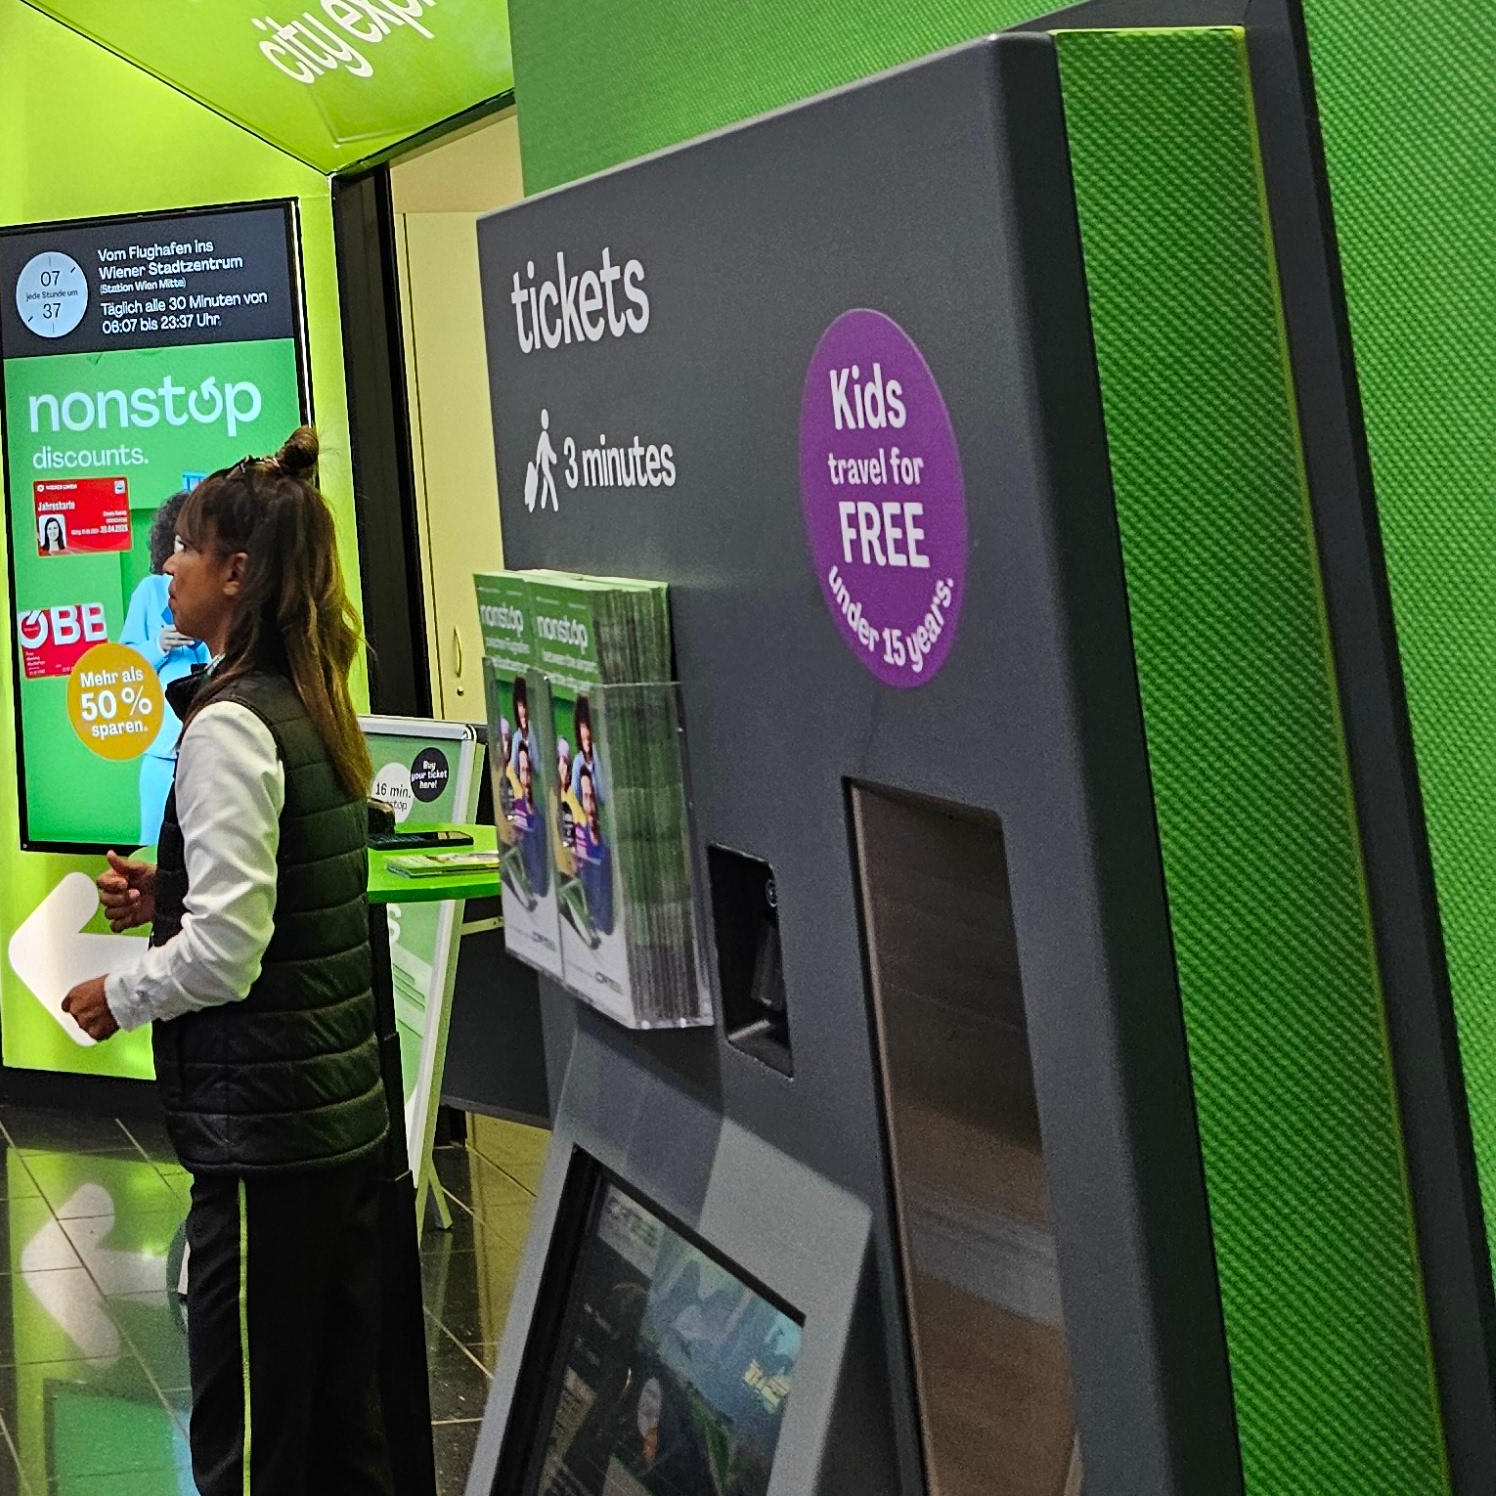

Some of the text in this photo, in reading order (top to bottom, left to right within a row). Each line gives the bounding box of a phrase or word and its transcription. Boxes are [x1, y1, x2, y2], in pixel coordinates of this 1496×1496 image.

[251, 11, 374, 85] city
[97, 239, 215, 262] Vom Flughafen ins
[40, 270, 61, 287] 07
[98, 256, 244, 280] Wiener Stadtzentrum
[43, 302, 62, 320] 37
[100, 292, 268, 319] Täglich alle 30 Minuten von
[510, 246, 650, 354] tickets
[140, 318, 159, 332] bis
[160, 314, 194, 330] 23:37
[29, 375, 262, 437] nonstop
[829, 362, 907, 431] Kids
[32, 444, 149, 470] discounts.
[564, 434, 677, 489] 3 minutes
[828, 446, 924, 486] travel for
[838, 500, 931, 569] FREE
[828, 565, 954, 673] under 15 years.
[536, 614, 589, 655] nonstop
[80, 666, 144, 688] Mehr als
[80, 685, 153, 722] 50 %
[91, 719, 148, 741] sparen.
[410, 769, 448, 782] your ticket
[422, 760, 437, 771] Buy
[375, 782, 412, 799] 16 min.
